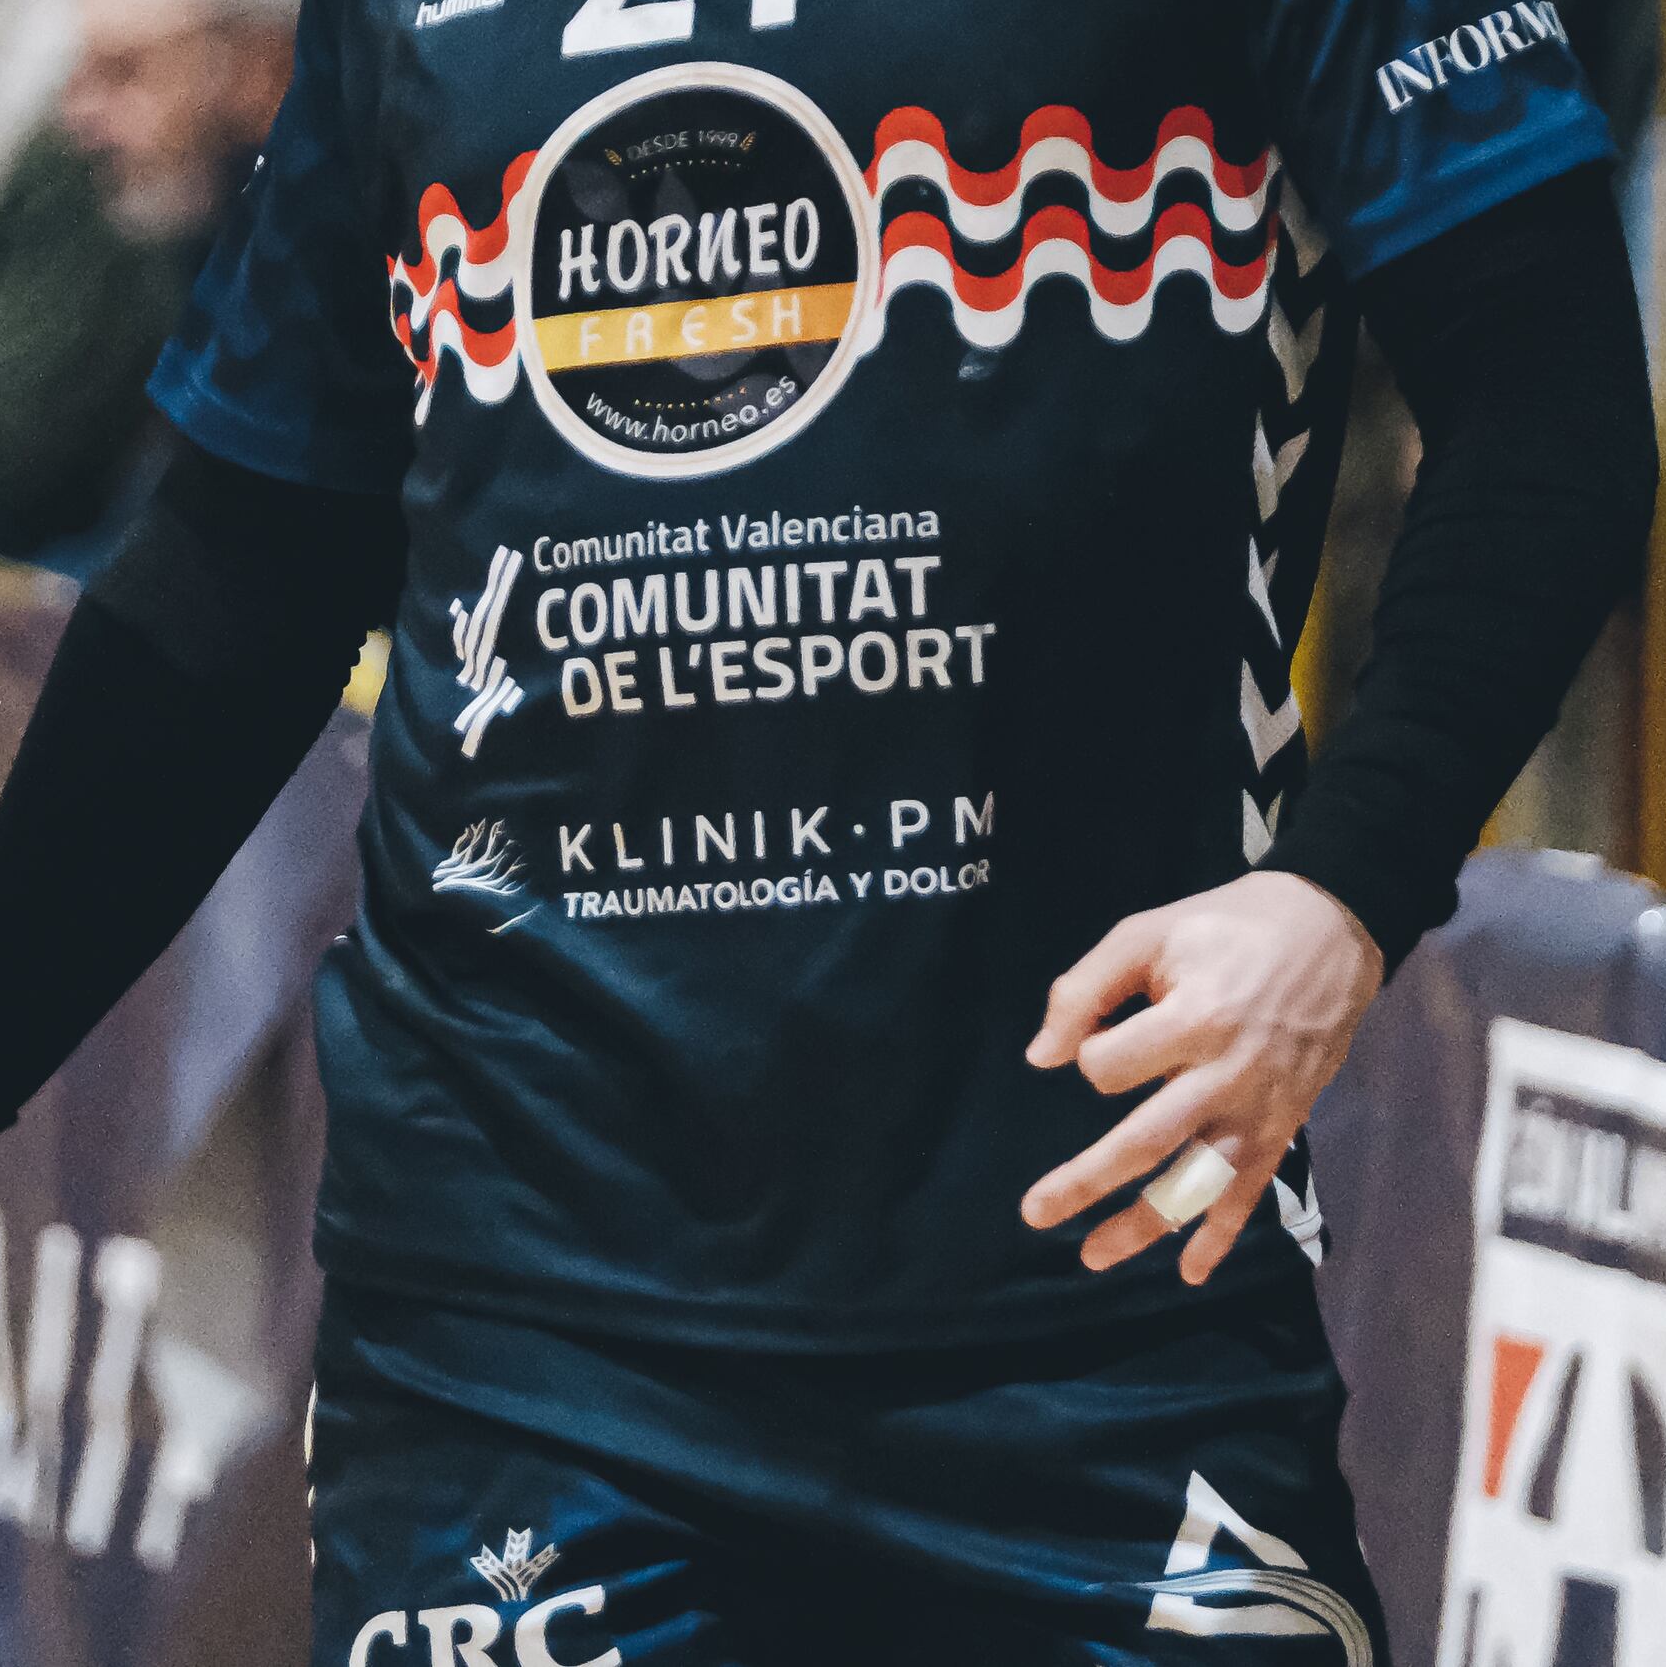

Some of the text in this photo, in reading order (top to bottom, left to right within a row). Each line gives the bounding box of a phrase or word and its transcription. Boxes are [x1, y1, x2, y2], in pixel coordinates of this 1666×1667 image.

[626, 130, 690, 162] DESDE
[558, 197, 820, 303] HORNEO
[586, 375, 797, 444] www.horneo.es
[532, 504, 941, 575] Comunitat Valenciana
[535, 555, 942, 652] COMUNITAT
[560, 649, 643, 719] DE
[563, 858, 991, 919] TRAUMATOLOGÍA Y DOLOR
[349, 1584, 622, 1667] CRC
